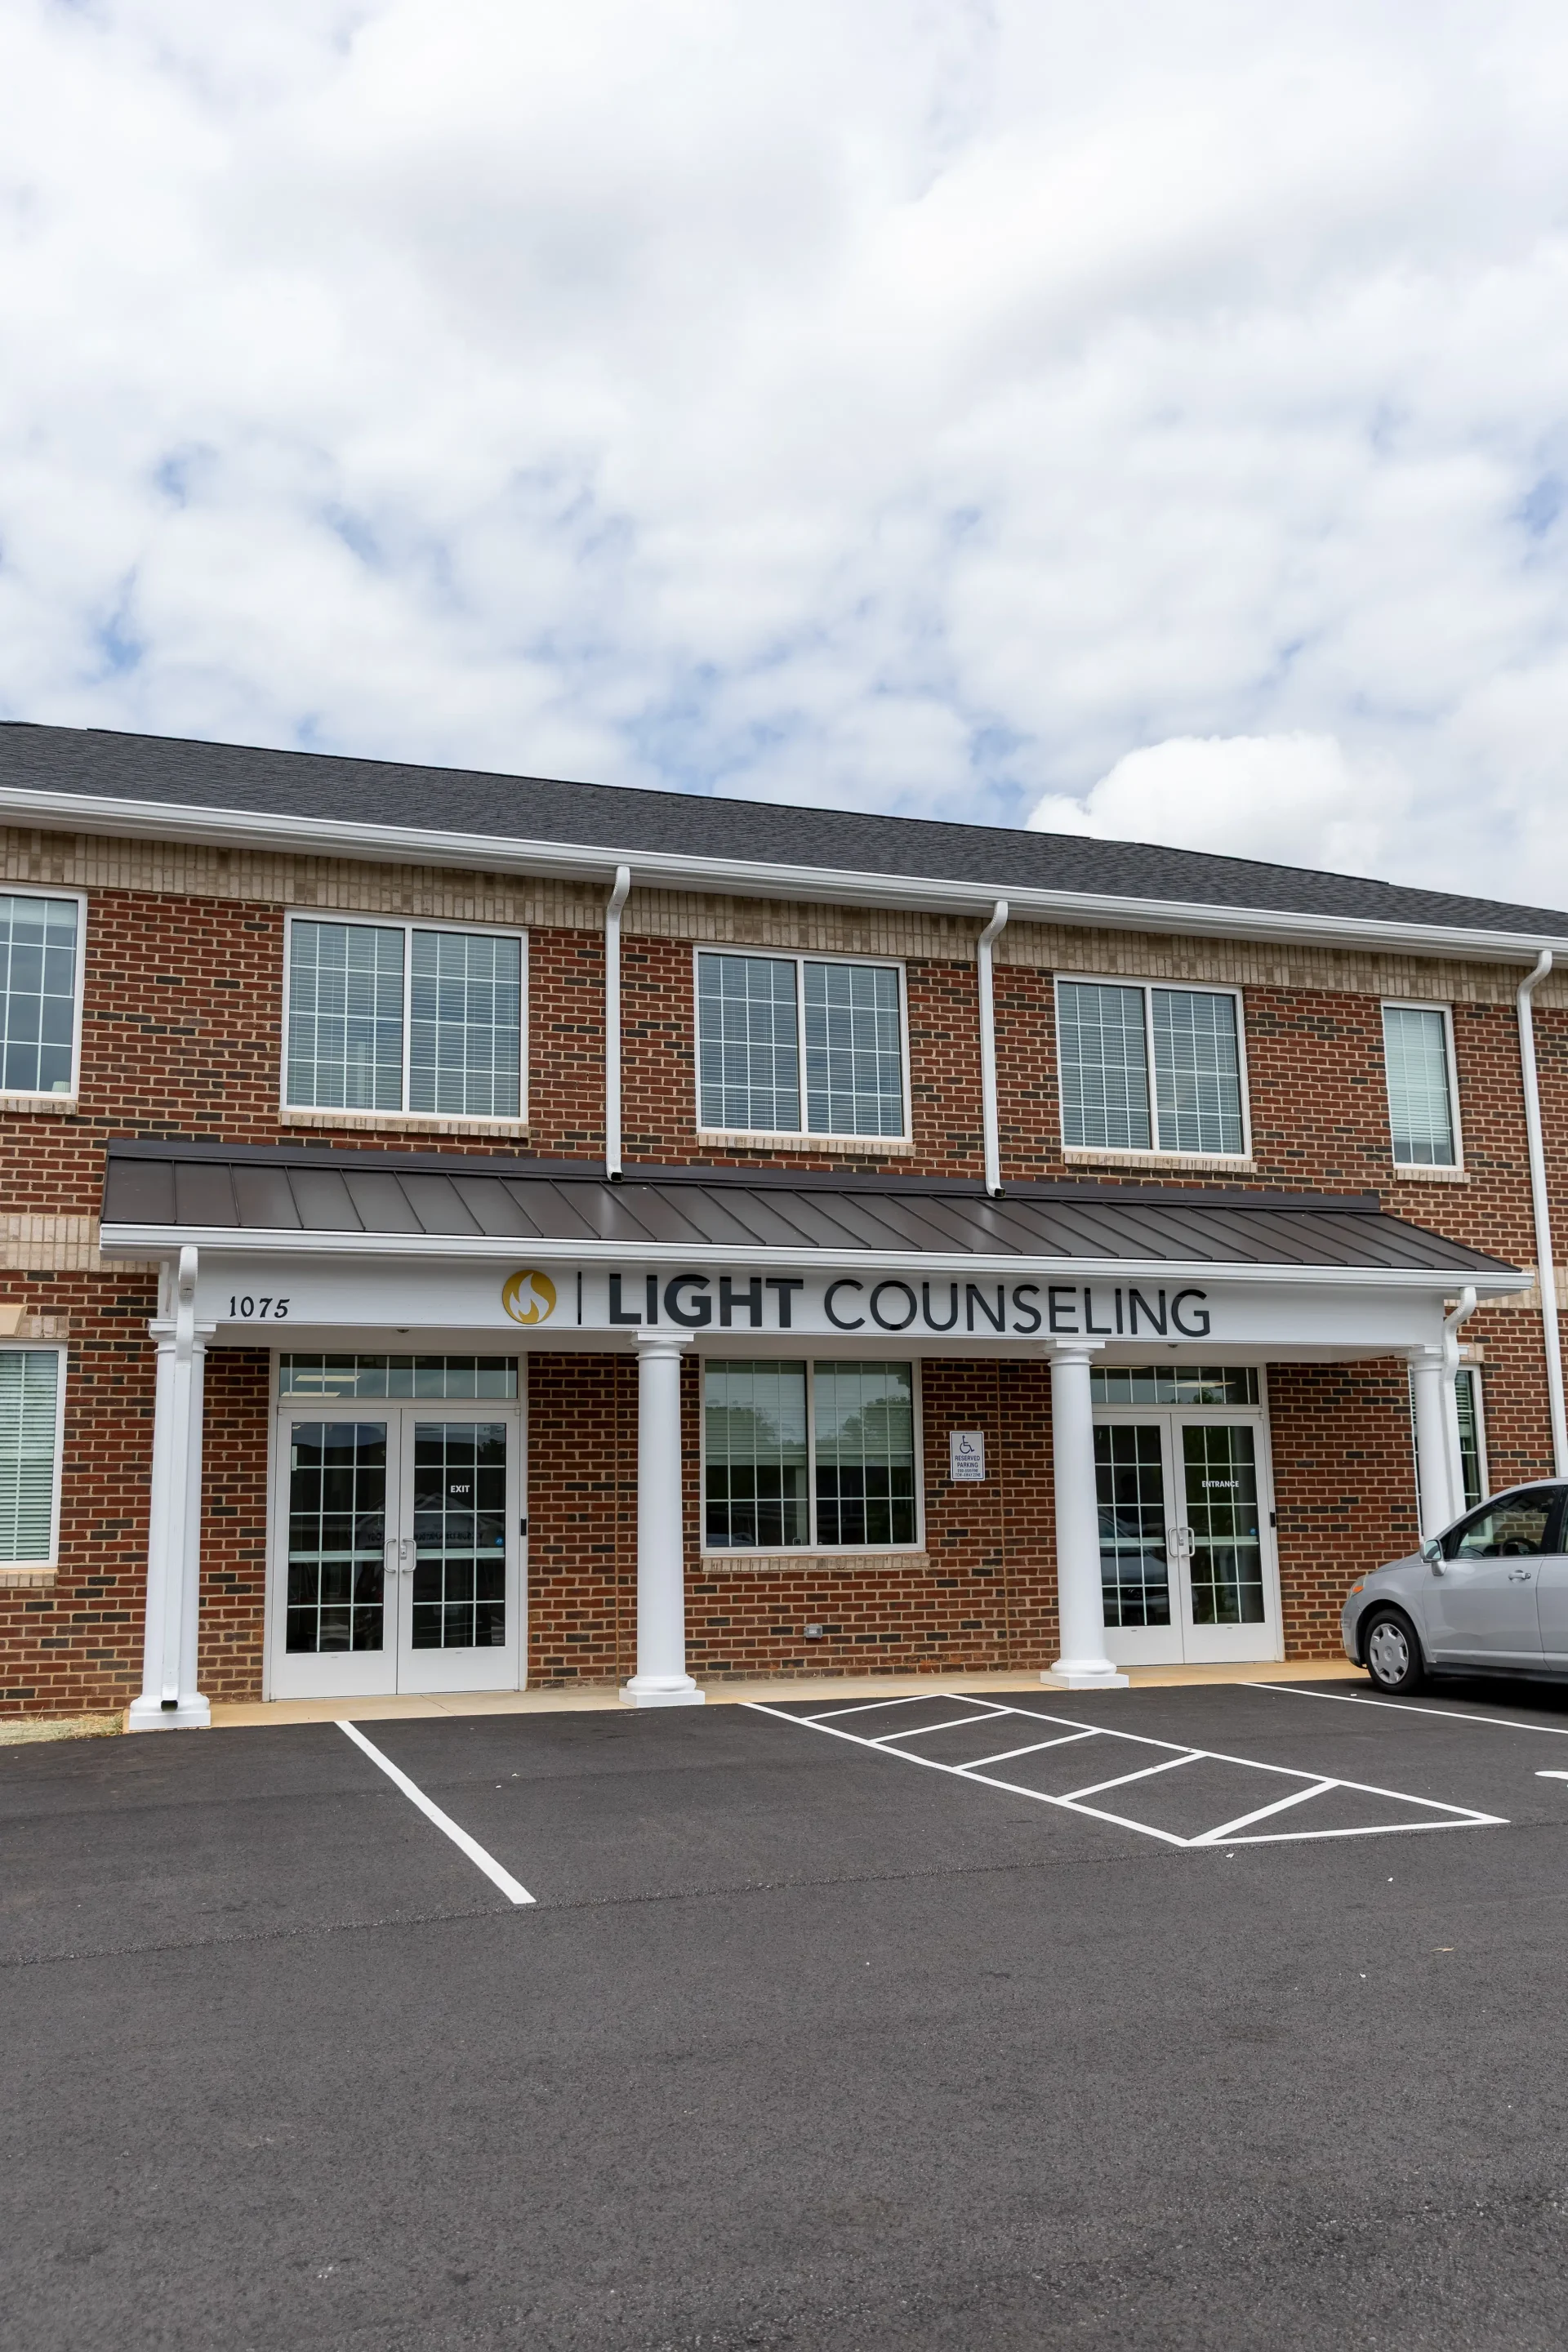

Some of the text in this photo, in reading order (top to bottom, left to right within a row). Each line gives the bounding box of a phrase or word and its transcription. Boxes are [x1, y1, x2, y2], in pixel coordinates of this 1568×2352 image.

[229, 1296, 290, 1318] 1075
[609, 1273, 1211, 1338] LIGHT COUNSELING
[450, 1485, 470, 1494] EXIT
